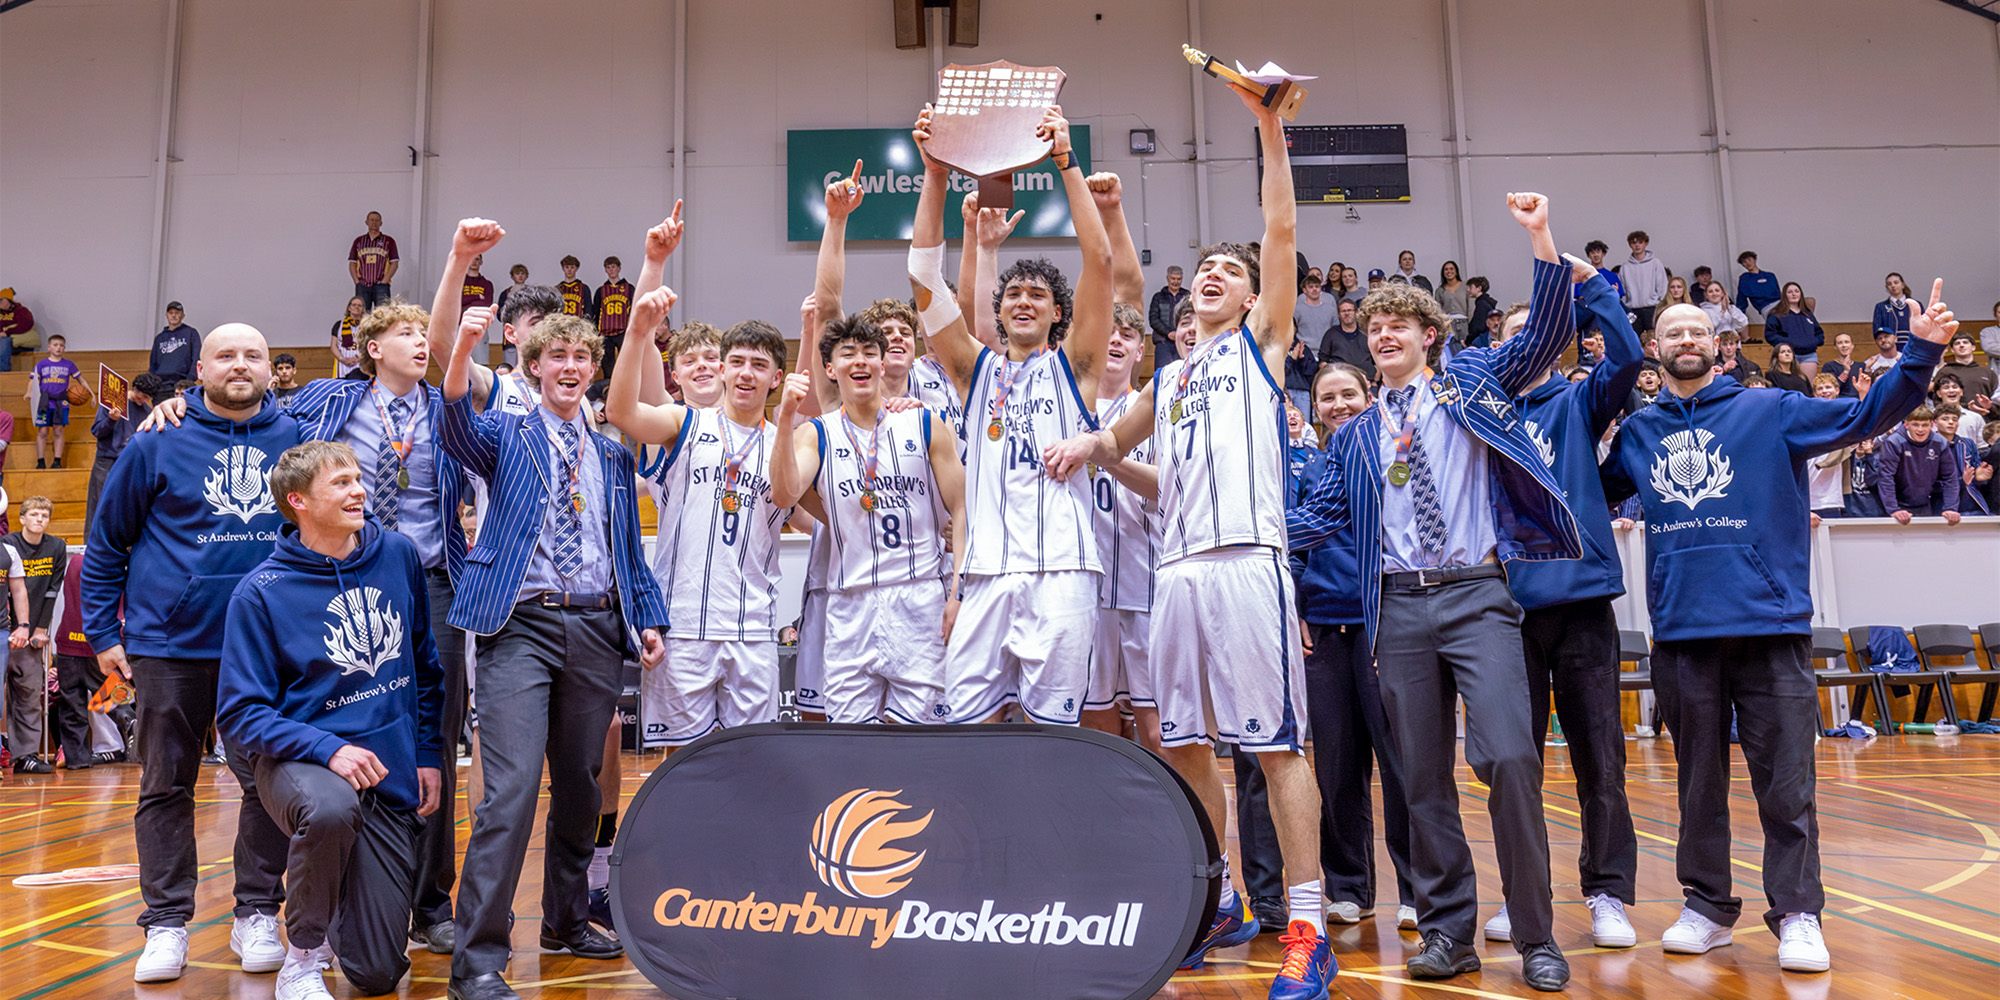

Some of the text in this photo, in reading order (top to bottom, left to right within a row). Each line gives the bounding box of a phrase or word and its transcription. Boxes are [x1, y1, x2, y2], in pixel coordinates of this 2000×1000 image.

[823, 169, 1054, 194] Cwles taum
[606, 302, 623, 315] 66
[108, 373, 121, 393] GO
[1169, 374, 1237, 409] ADREW'S
[1181, 396, 1211, 419] LLEGE
[1181, 419, 1197, 460] 7
[1009, 436, 1038, 470] 14
[693, 466, 709, 485] ST
[838, 476, 925, 497] ST ADREW'S
[876, 496, 911, 509] LLEGE
[722, 511, 740, 547] 9
[881, 514, 902, 549] 8
[1650, 516, 1748, 534] St Andrew's College
[197, 531, 278, 544] St Andrew's Coll
[325, 700, 337, 710] St
[338, 684, 387, 706] Andrew's
[620, 711, 637, 725] ke
[653, 887, 1144, 950] Canterbury Basketball
